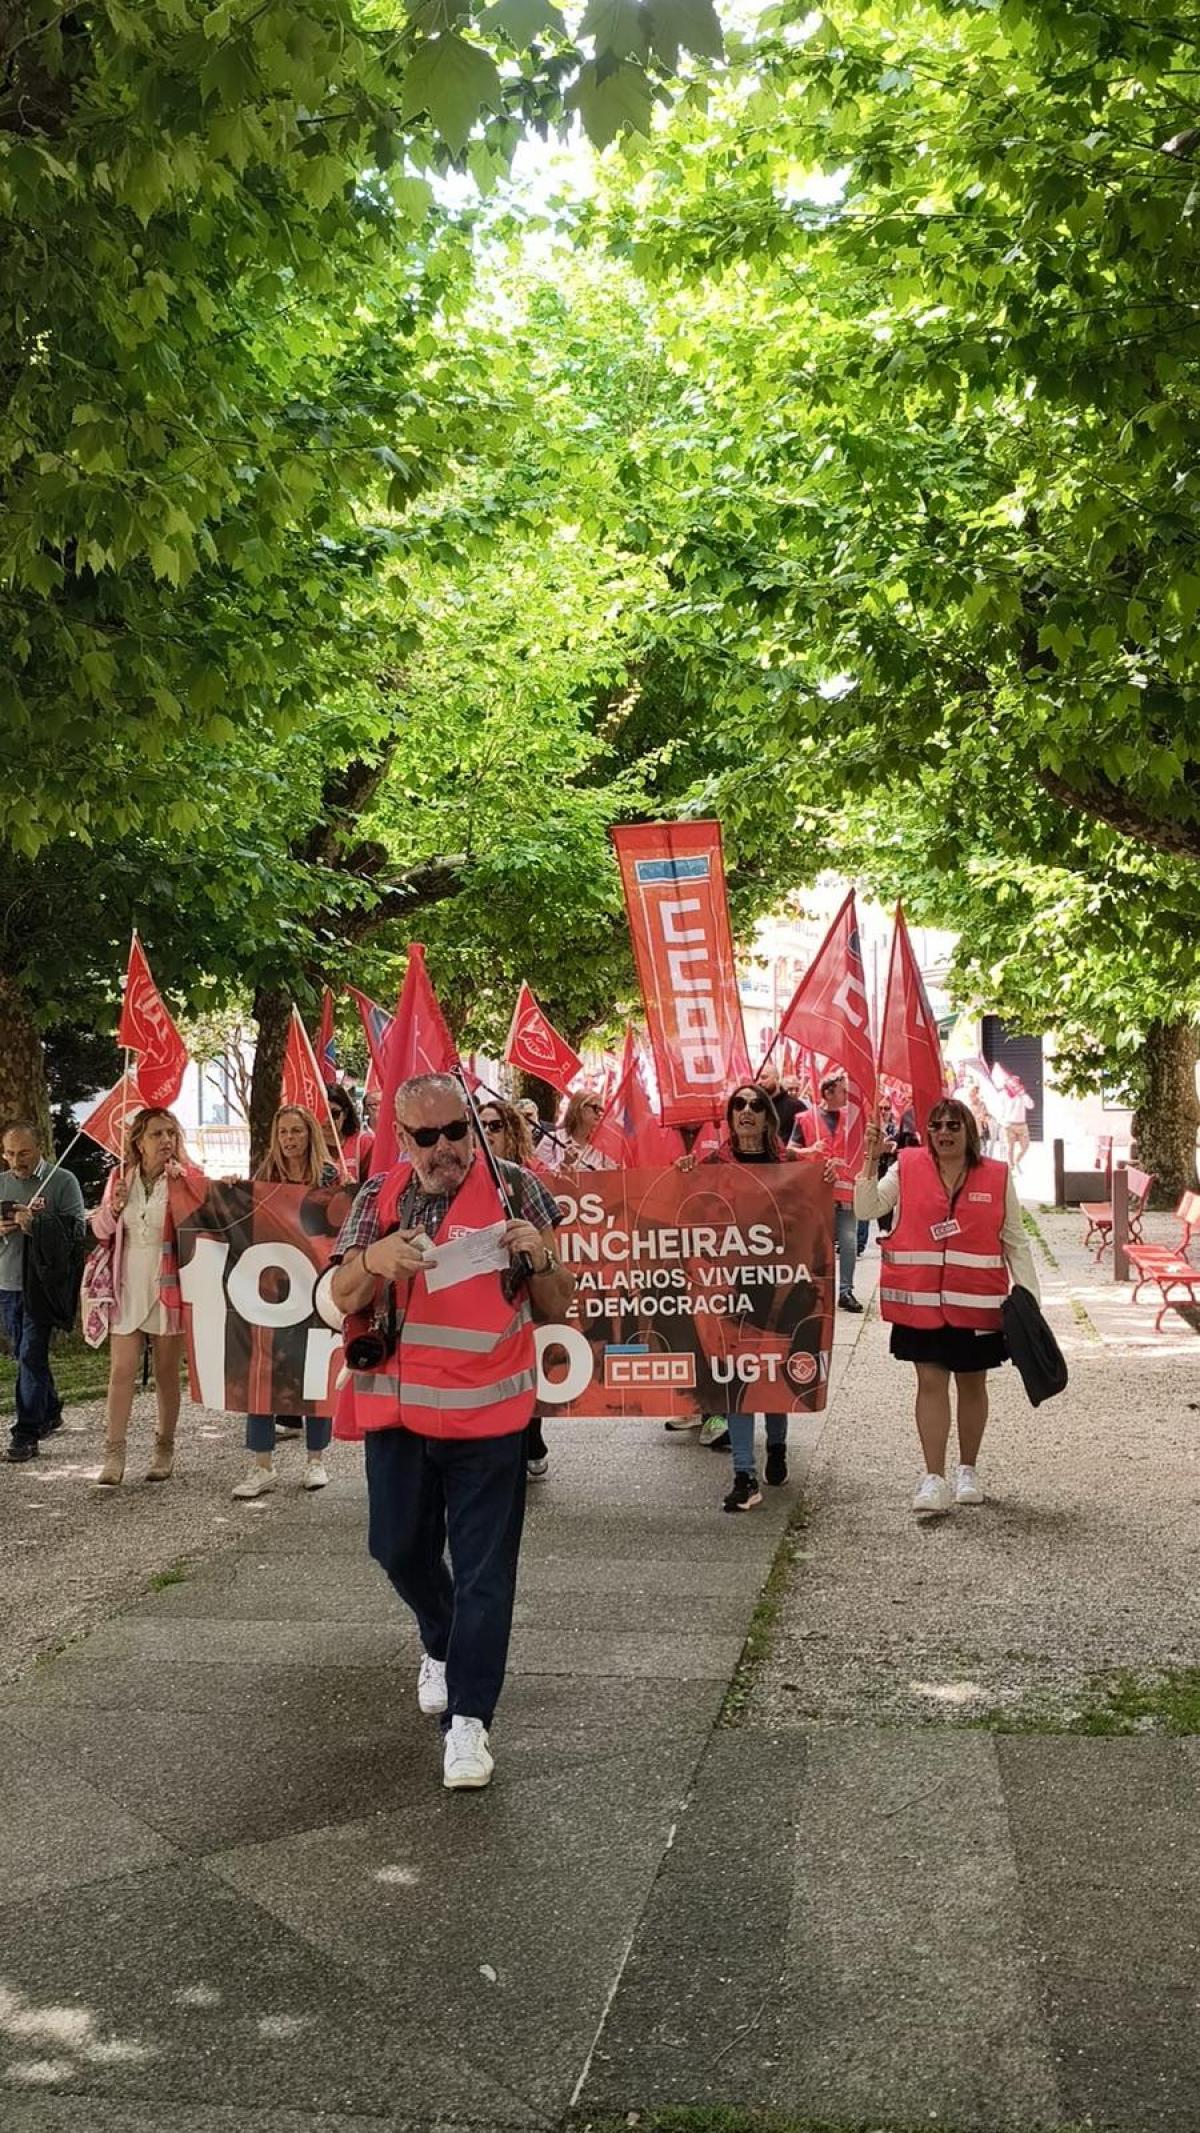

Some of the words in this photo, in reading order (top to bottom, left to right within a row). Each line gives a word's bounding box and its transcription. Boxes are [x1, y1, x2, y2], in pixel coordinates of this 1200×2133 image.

[659, 898, 726, 1083] CCOO
[557, 1193, 614, 1229] OS,
[560, 1224, 785, 1263] INCHEIRAS.
[698, 1264, 813, 1287] VIVENDA
[586, 1293, 755, 1319] DEMOCRACIA
[611, 1359, 689, 1381] CCOO
[711, 1353, 783, 1384] UGT
